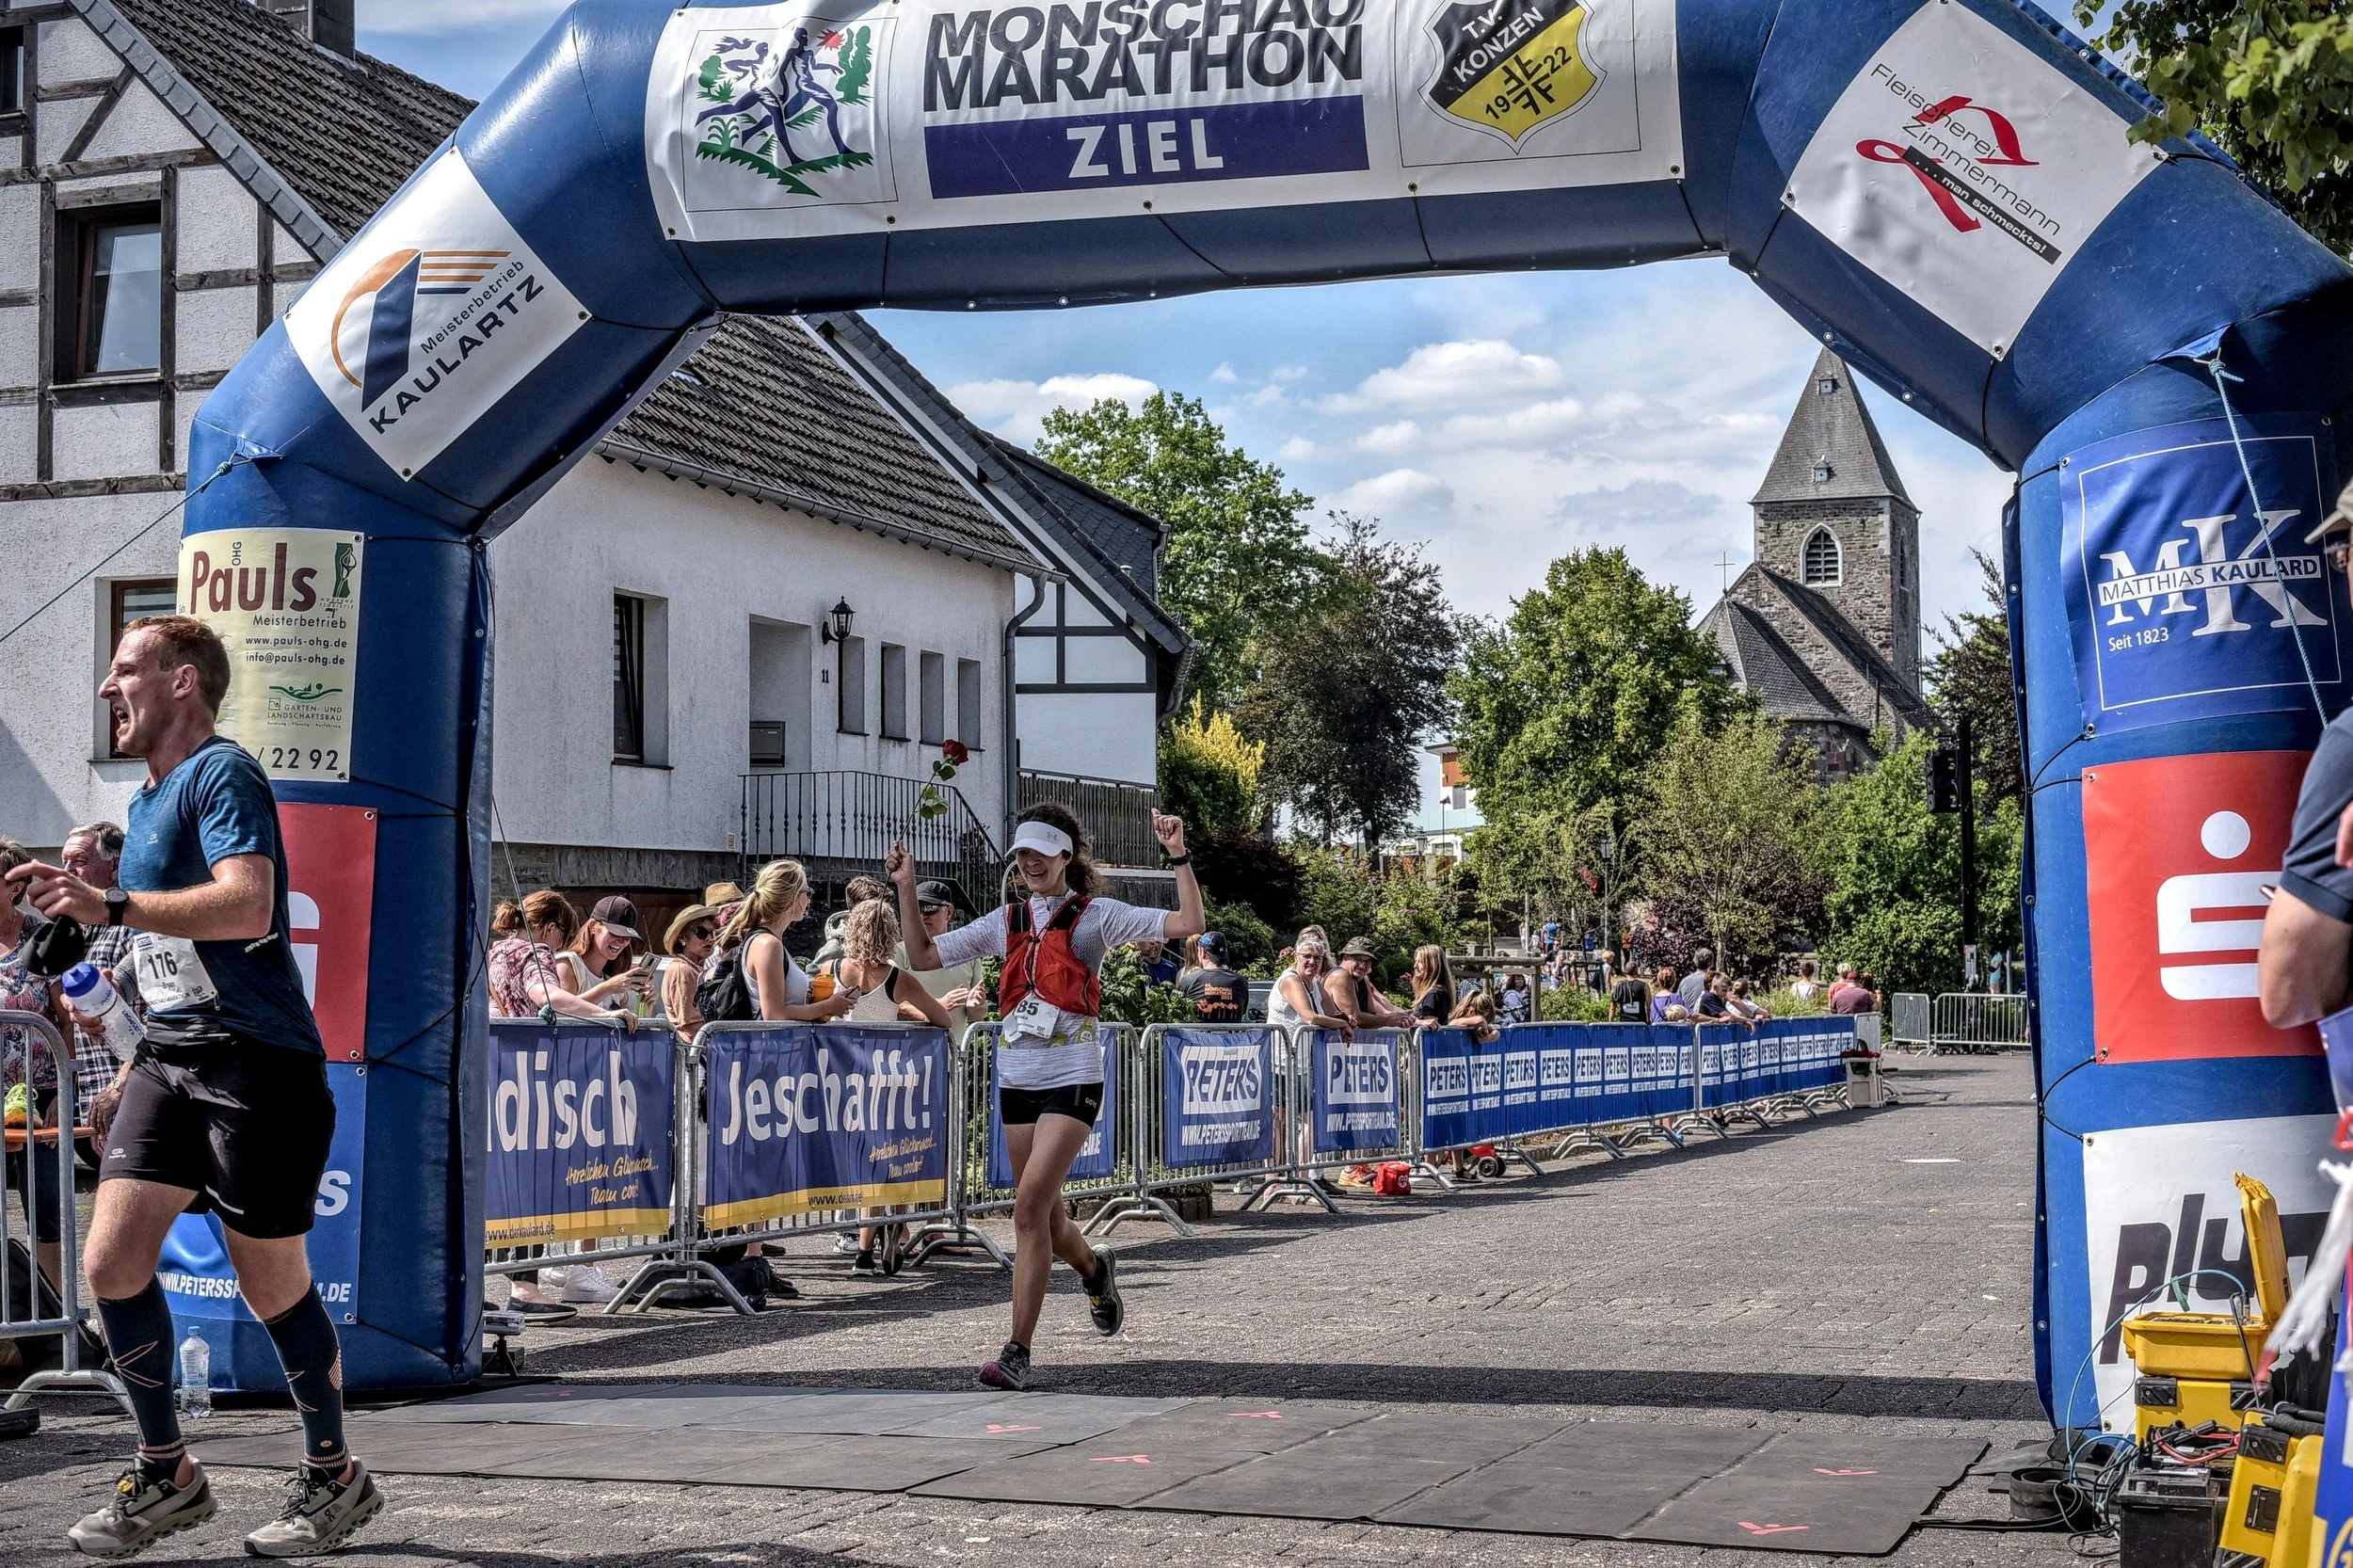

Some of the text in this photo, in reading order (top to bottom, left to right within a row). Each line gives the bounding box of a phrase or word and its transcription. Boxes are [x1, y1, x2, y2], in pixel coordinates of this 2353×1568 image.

[926, 0, 1365, 57] MONSCHAU
[1452, 7, 1545, 83] KONZEN
[1462, 8, 1503, 39] T.V.
[923, 24, 1364, 112] MARATHON
[1869, 62, 2000, 158] Fleischerei
[1066, 119, 1224, 179] ZIEL
[1902, 116, 2061, 236] Zimmermann
[1972, 197, 2047, 254] schmeckts!
[420, 260, 524, 354] Meisterbetrieb
[369, 275, 544, 435] KAULARTZ
[232, 541, 242, 566] OHG
[189, 543, 318, 615] Pauls
[2102, 557, 2318, 602] MATTHIAS KAULARD
[245, 635, 347, 648] www.pauls-ohg.de
[252, 614, 347, 629] Meisterbetrieb
[2108, 627, 2169, 651] Seit 1823
[246, 651, 345, 665] info@pauls-ohg.de
[267, 712, 342, 721] LANDSCHAFTSBAU
[148, 951, 178, 979] 176
[1186, 1057, 1259, 1103] PETERS
[1330, 1055, 1389, 1095] PETERS
[1431, 1056, 1466, 1091] PETERS
[722, 1048, 933, 1145] Jeschafft!
[591, 1186, 617, 1206] Team
